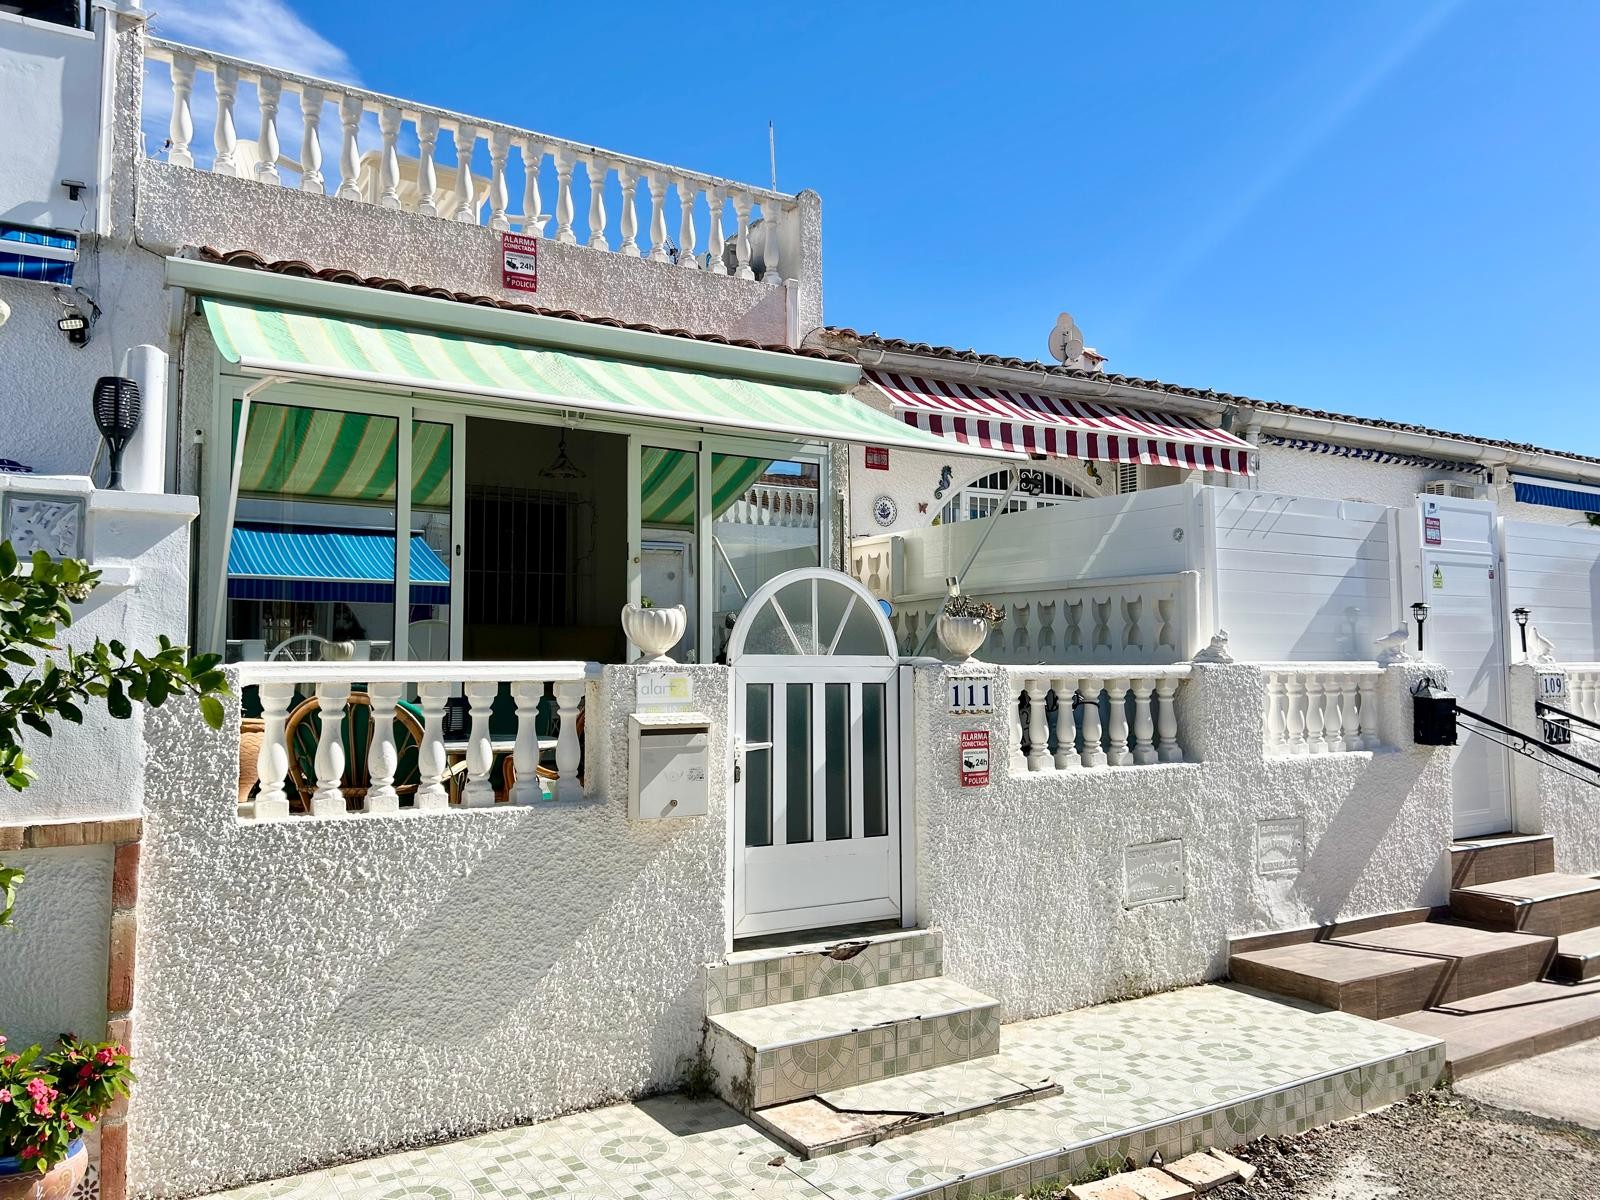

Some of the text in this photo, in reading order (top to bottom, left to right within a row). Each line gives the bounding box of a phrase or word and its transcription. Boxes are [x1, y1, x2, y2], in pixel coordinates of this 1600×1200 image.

[504, 235, 535, 247] ALARMA
[504, 242, 536, 252] CONECTADA
[519, 262, 534, 271] 24h
[1544, 677, 1562, 694] 109
[952, 684, 991, 707] 111
[962, 733, 988, 741] ALARMA
[961, 740, 988, 748] CONECTADA
[975, 758, 988, 767] 24h
